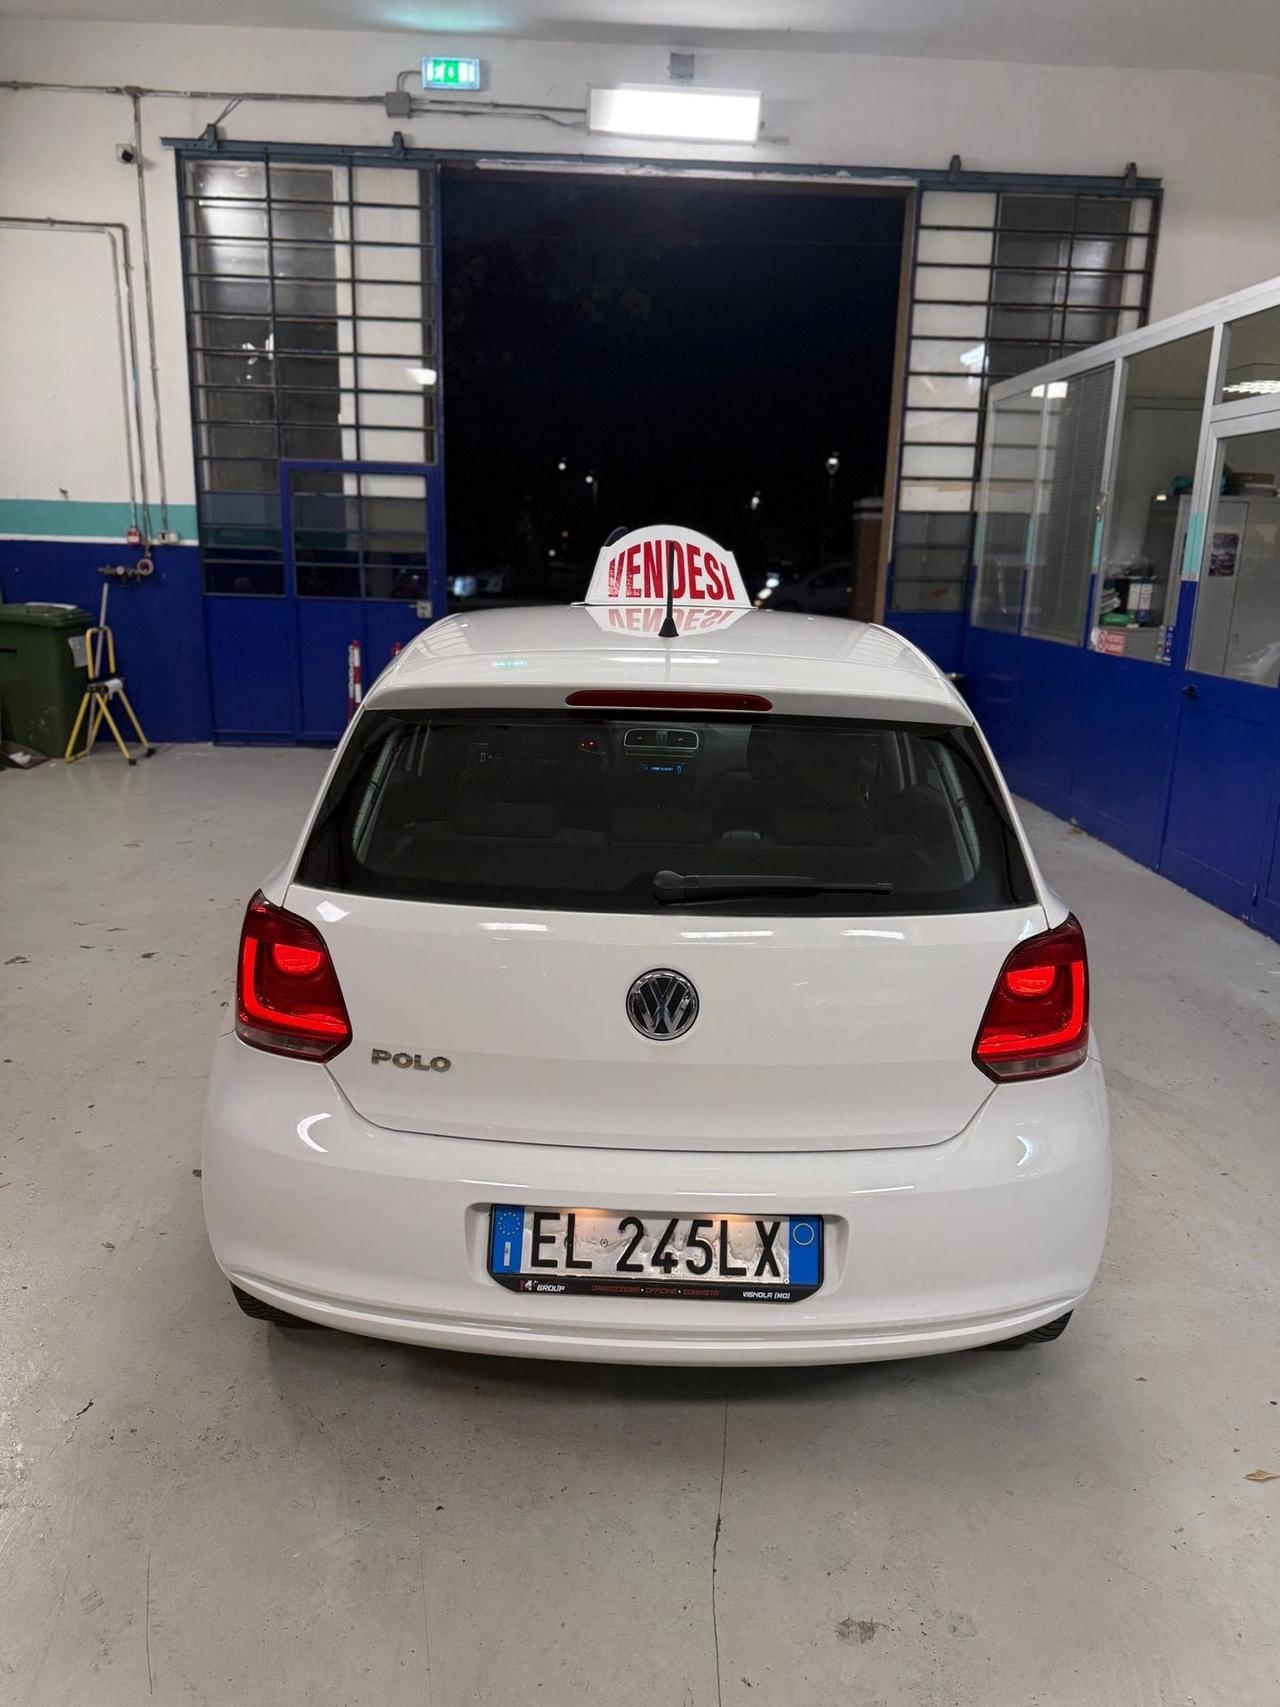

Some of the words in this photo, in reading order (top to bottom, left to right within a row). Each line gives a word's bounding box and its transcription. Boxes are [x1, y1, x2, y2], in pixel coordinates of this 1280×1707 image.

[608, 540, 735, 600] VENDESI
[371, 1048, 452, 1073] POLO
[531, 1212, 592, 1268] EL
[617, 1216, 781, 1277] 245LX
[536, 1284, 566, 1292] GROUP
[742, 1291, 773, 1299] VIGNOLA
